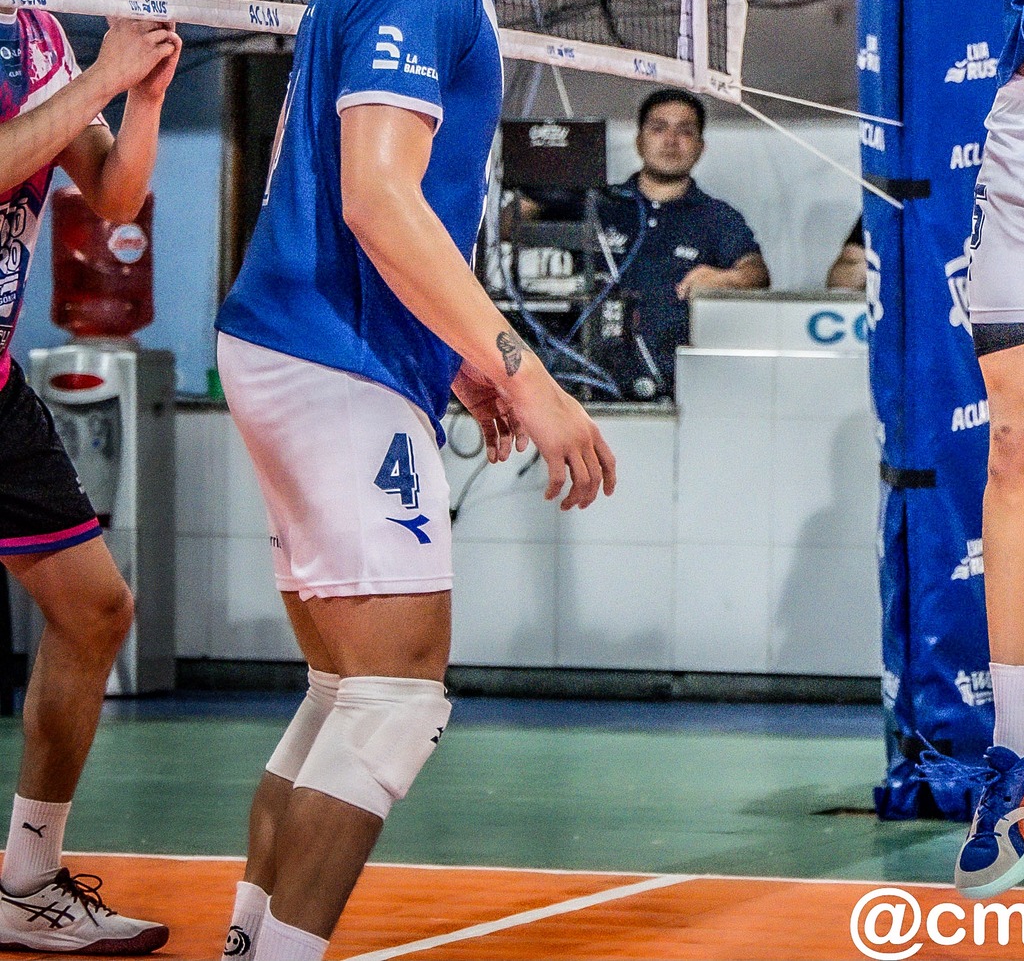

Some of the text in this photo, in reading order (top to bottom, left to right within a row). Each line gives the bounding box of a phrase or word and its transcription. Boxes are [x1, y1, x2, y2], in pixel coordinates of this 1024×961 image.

[249, 4, 280, 27] ACLAV
[406, 53, 418, 64] LA
[950, 142, 983, 170] ACL
[373, 432, 420, 509] 4
